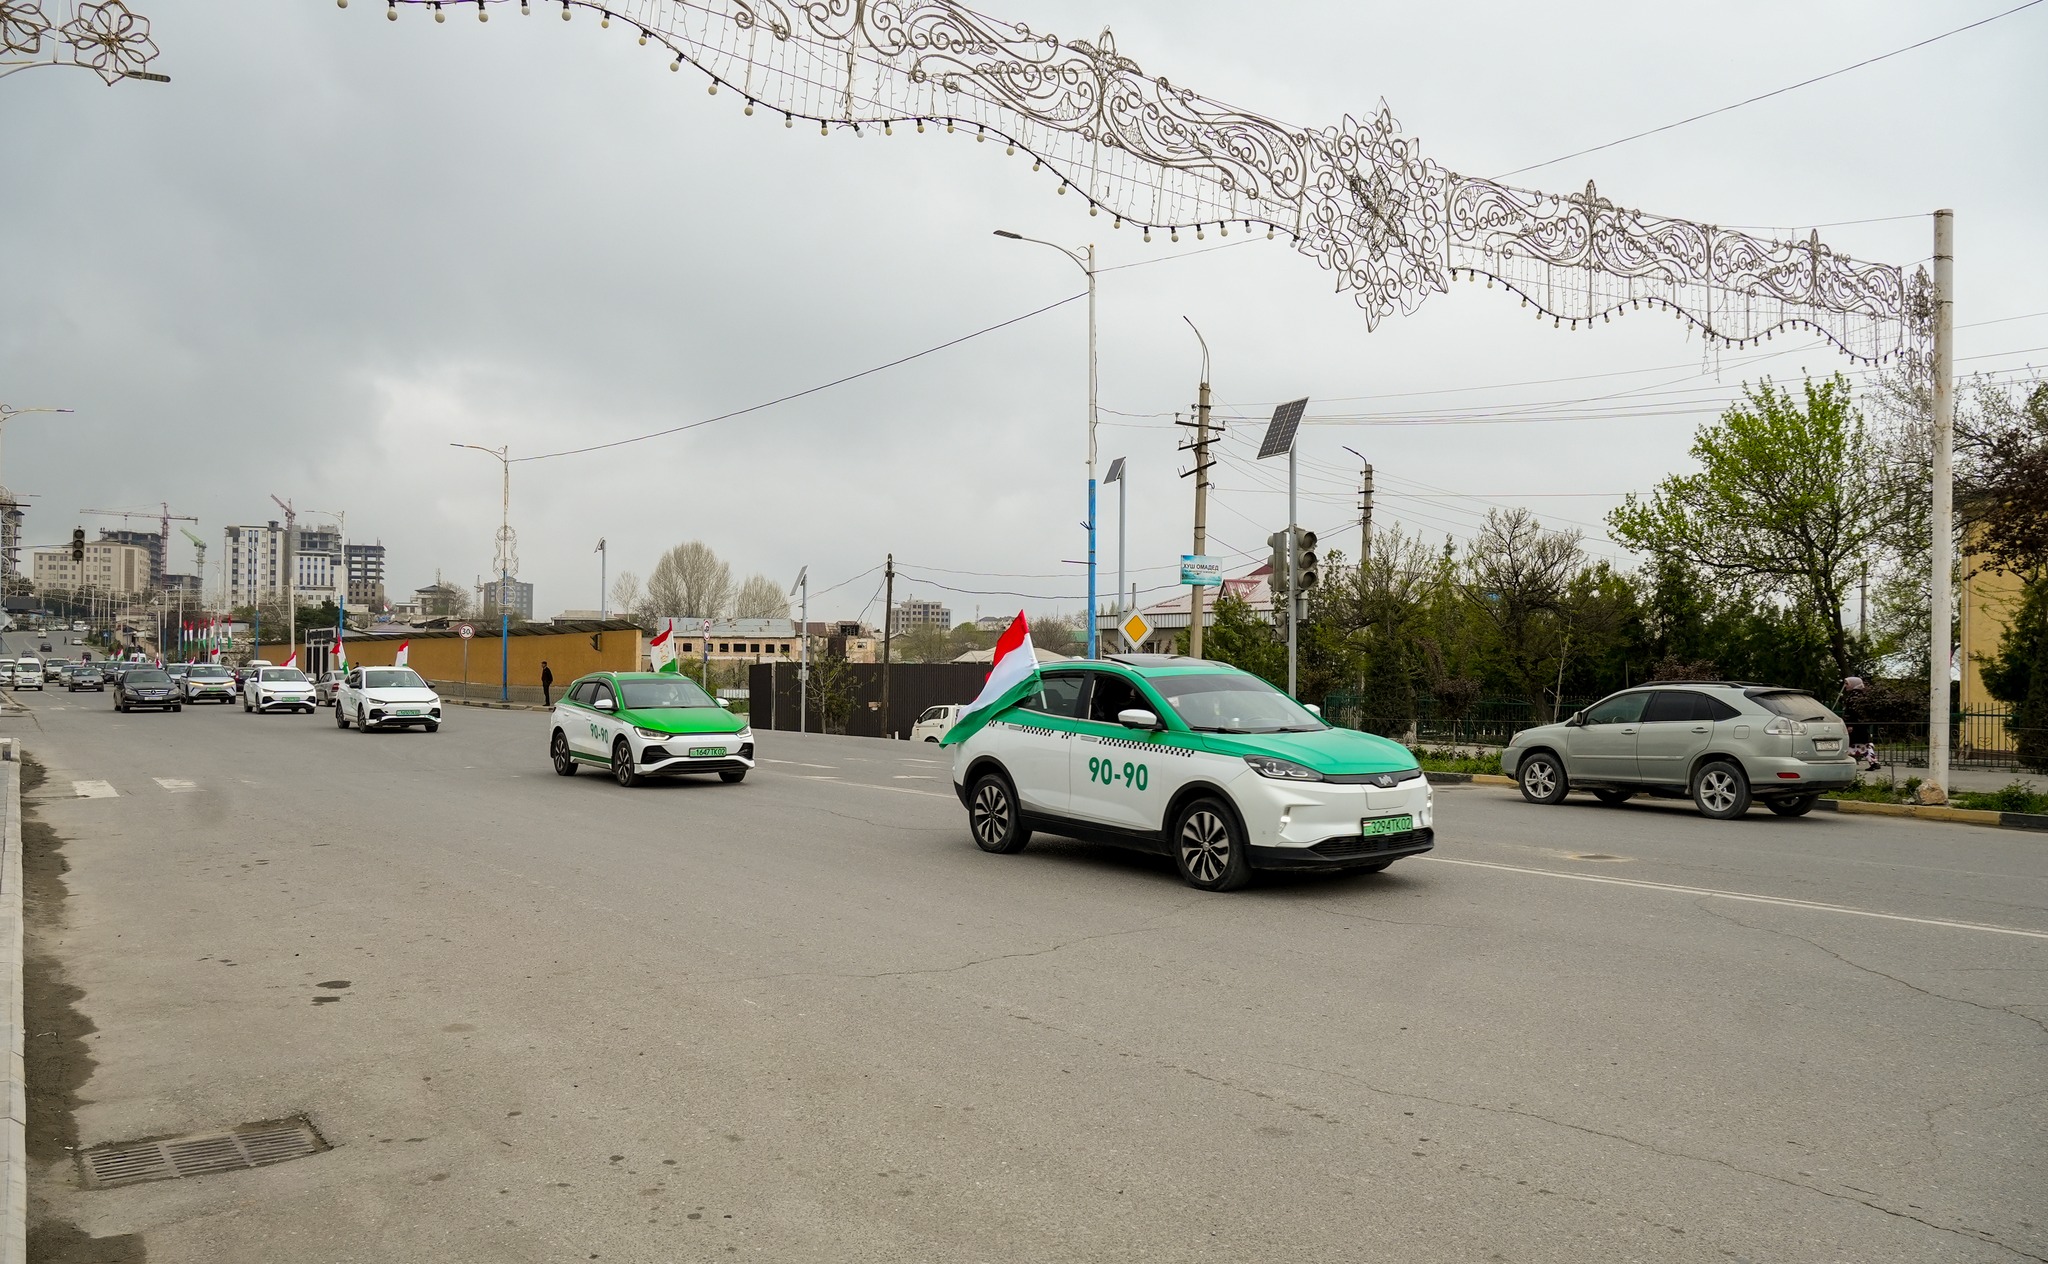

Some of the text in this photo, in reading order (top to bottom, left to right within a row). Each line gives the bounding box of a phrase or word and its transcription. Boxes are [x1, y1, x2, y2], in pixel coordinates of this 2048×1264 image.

[1196, 563, 1219, 571] ОМАДЕД
[461, 627, 471, 635] 30
[590, 723, 608, 744] 90-90
[1089, 756, 1148, 791] 90-90
